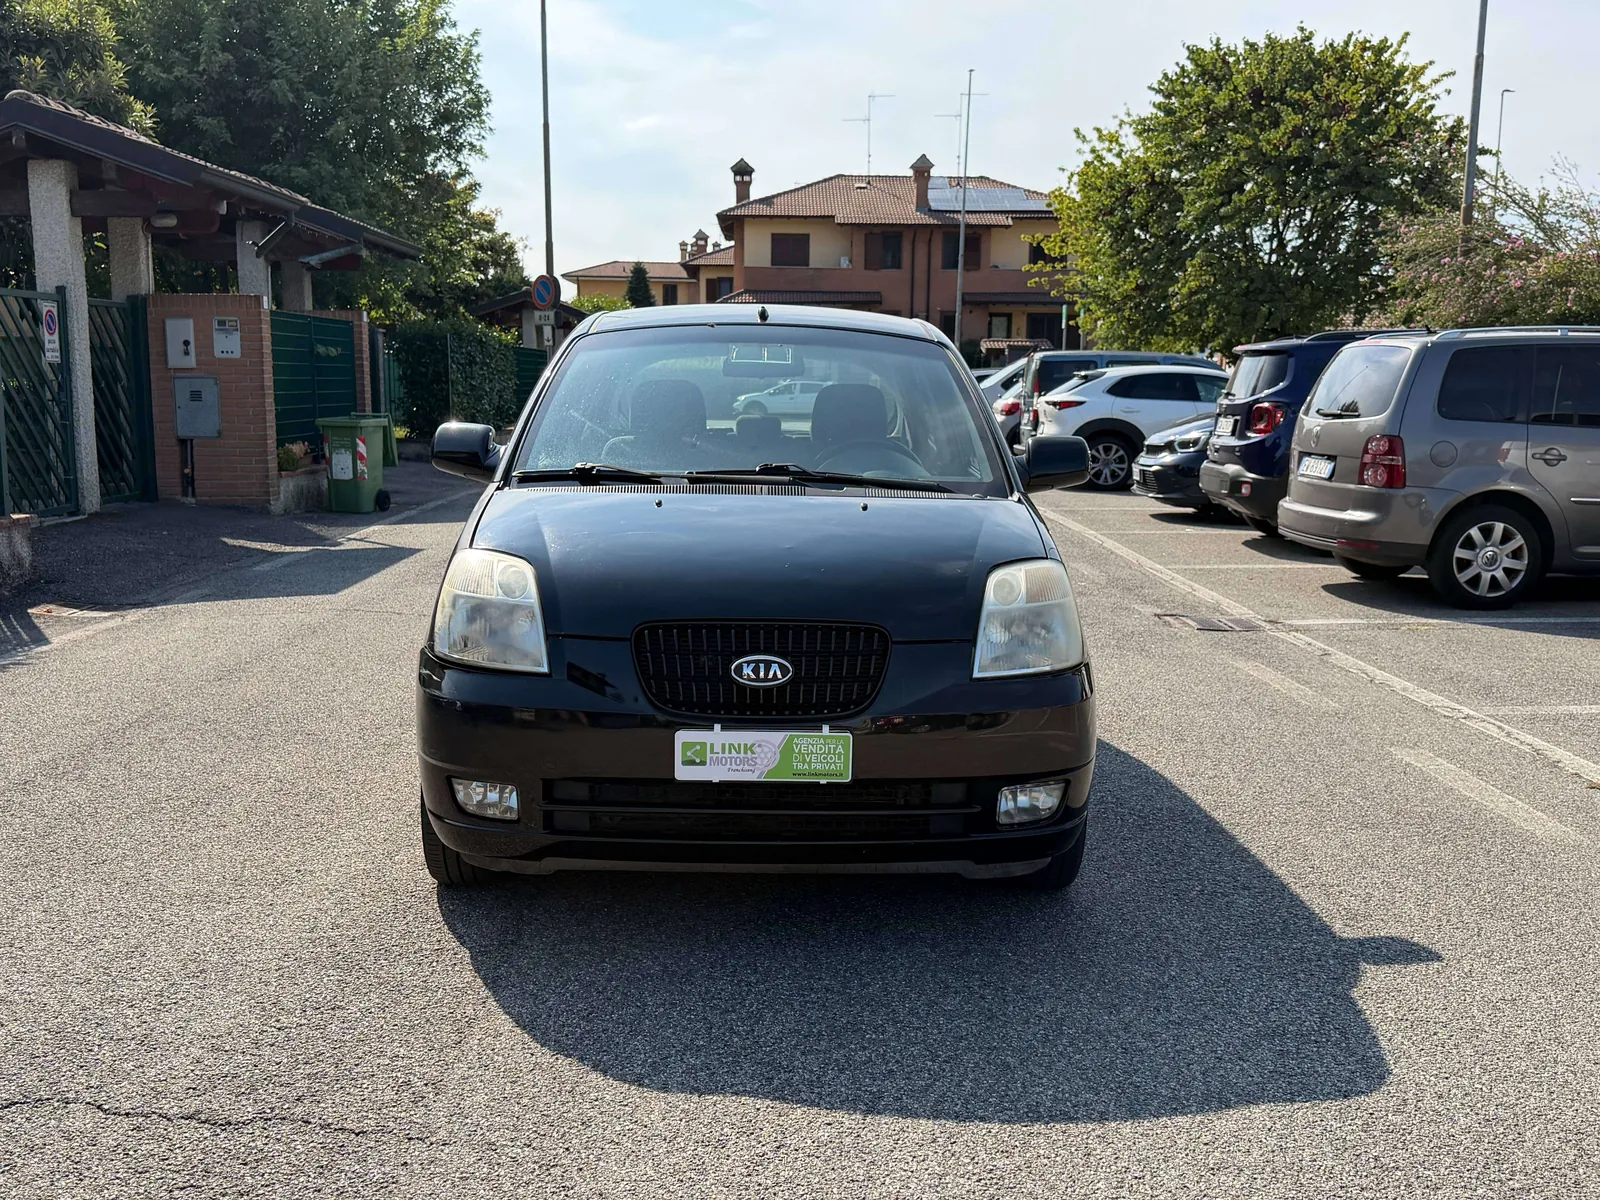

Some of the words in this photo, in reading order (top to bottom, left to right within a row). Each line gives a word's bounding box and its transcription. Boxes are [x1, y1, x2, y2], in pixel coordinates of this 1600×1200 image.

[742, 663, 783, 679] KIA
[709, 743, 757, 755] LINK
[793, 744, 844, 754] VENDITA
[709, 756, 758, 767] MOTORS
[793, 754, 802, 762] DI
[804, 754, 844, 763] VEICOLI
